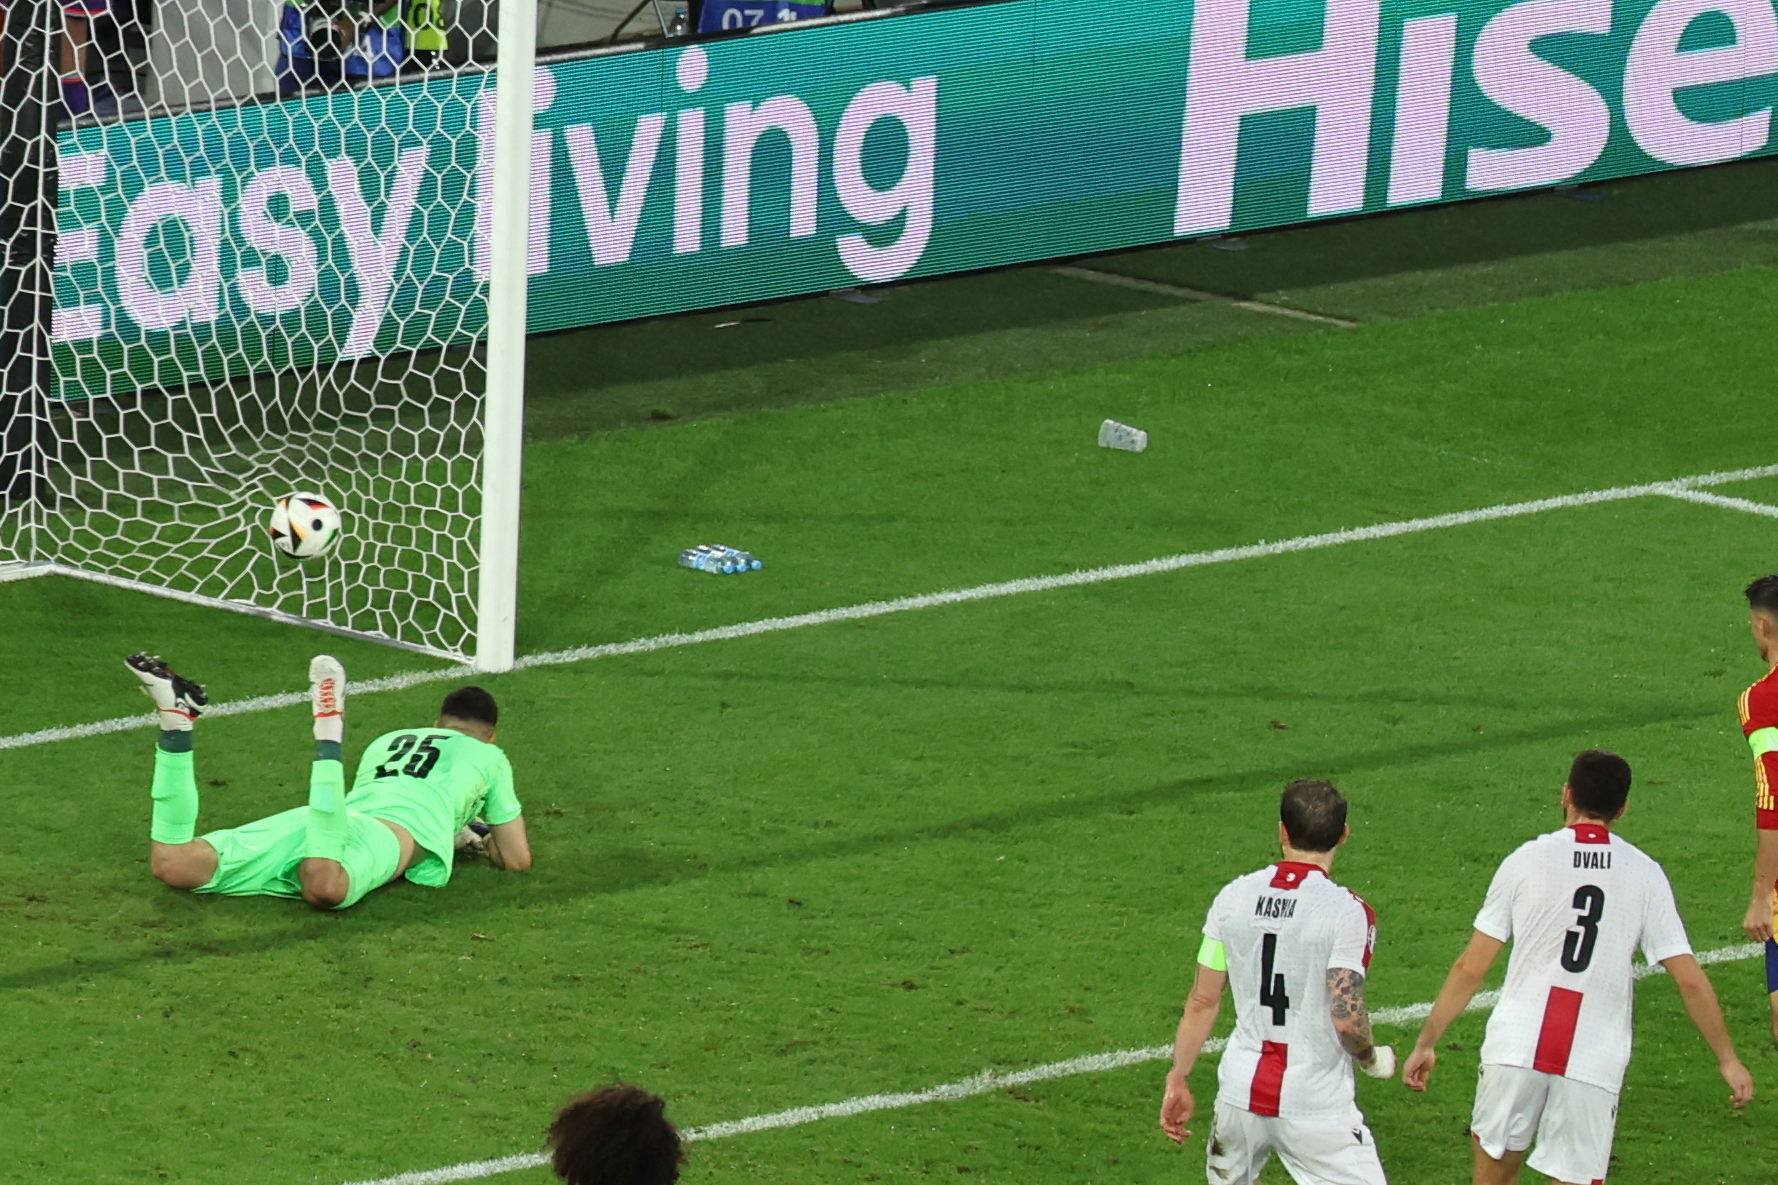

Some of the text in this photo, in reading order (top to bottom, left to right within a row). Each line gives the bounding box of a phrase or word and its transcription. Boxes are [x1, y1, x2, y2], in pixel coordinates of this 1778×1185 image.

[51, 46, 938, 362] Easy living
[374, 734, 451, 780] 25
[1573, 850, 1613, 870] DVALI
[1560, 884, 1606, 974] 3
[1259, 932, 1290, 1027] 4
